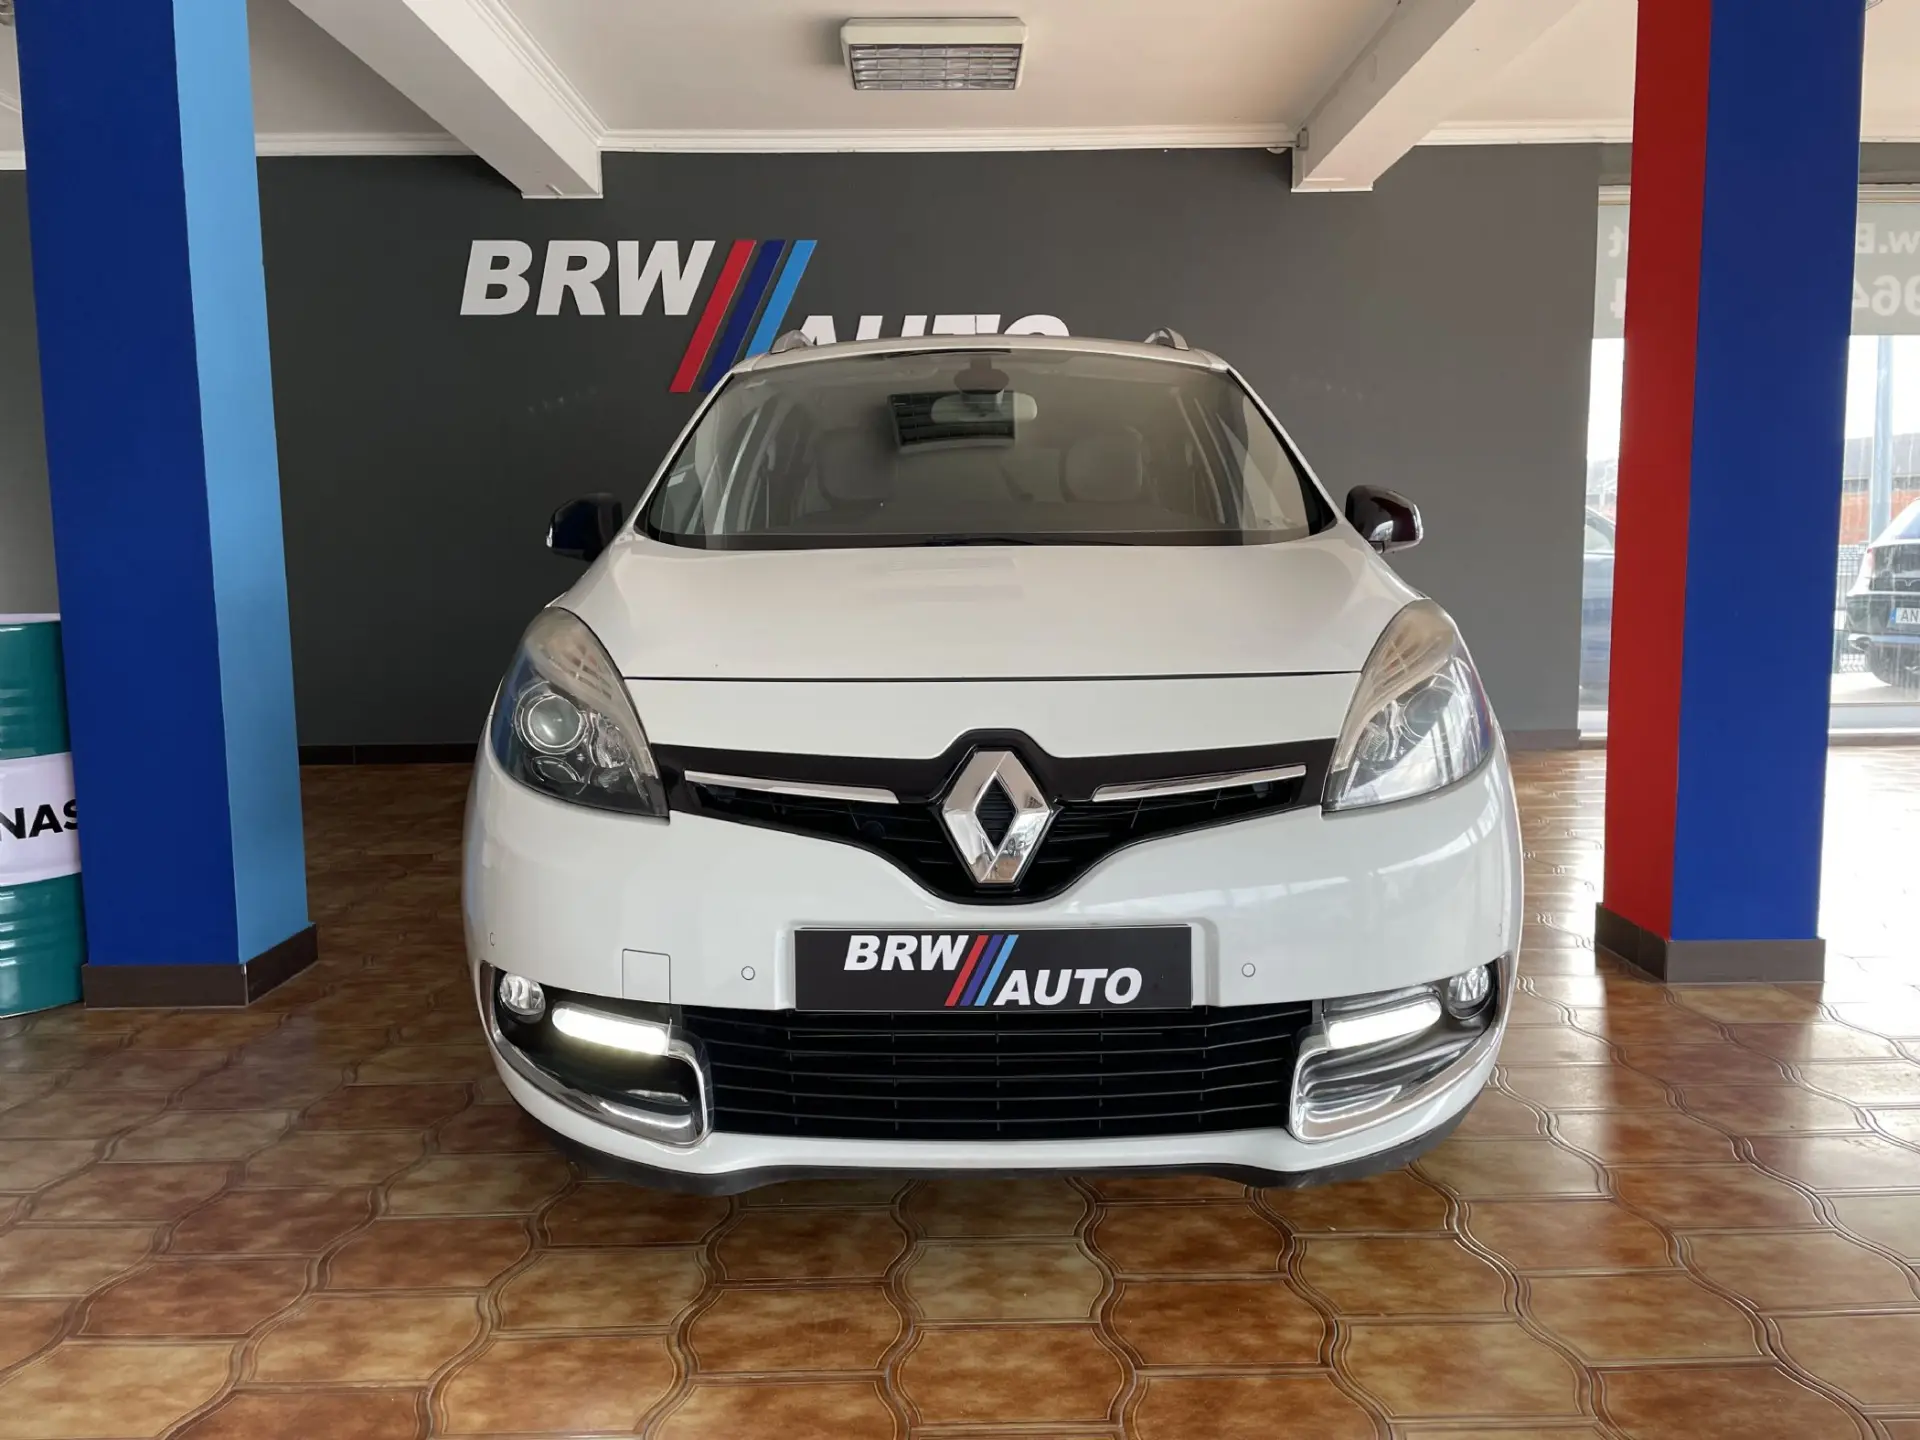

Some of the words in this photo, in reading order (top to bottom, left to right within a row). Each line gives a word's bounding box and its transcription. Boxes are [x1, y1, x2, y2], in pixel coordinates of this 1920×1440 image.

[459, 239, 716, 316] BRW
[844, 934, 969, 971] BRW
[994, 967, 1142, 1006] AUTO
